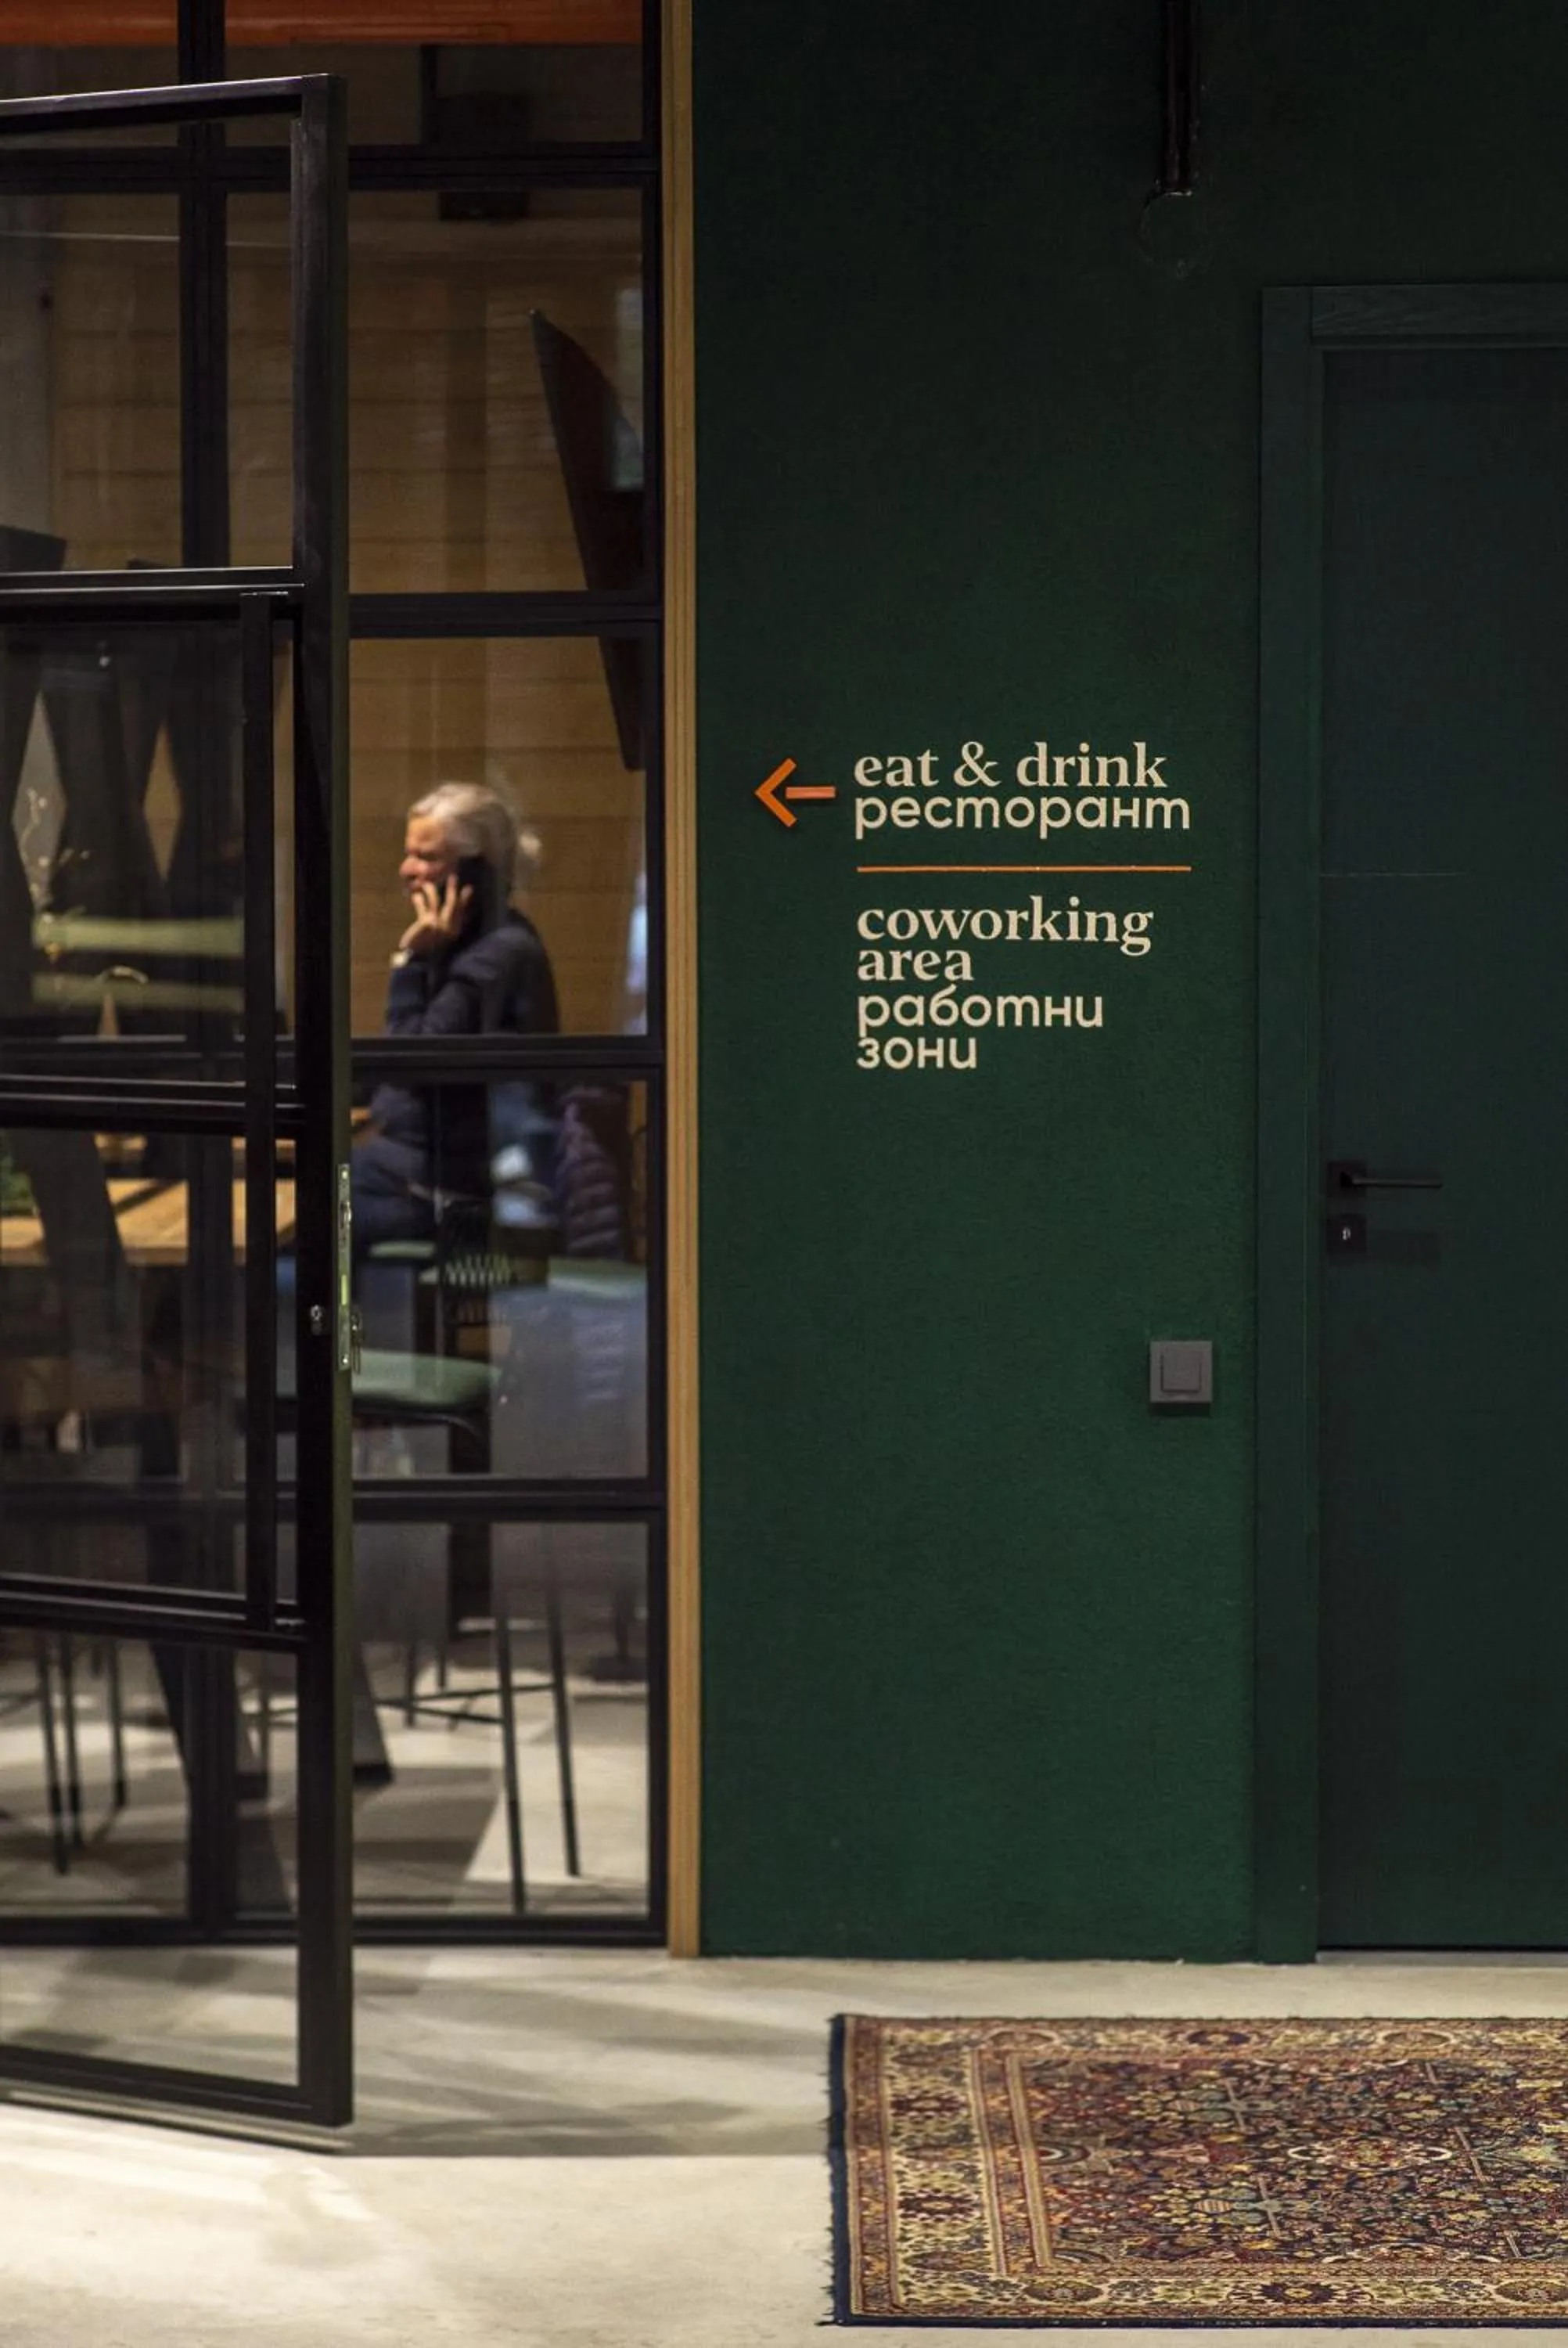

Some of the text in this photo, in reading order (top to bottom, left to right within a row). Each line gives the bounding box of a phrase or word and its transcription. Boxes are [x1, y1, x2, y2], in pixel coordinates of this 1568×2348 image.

[854, 740, 1168, 787] eat & drink
[855, 796, 1190, 840] ресторант
[857, 895, 1154, 956] coworking
[858, 949, 974, 981] area
[857, 983, 1103, 1037] работни
[857, 1036, 976, 1069] зони
